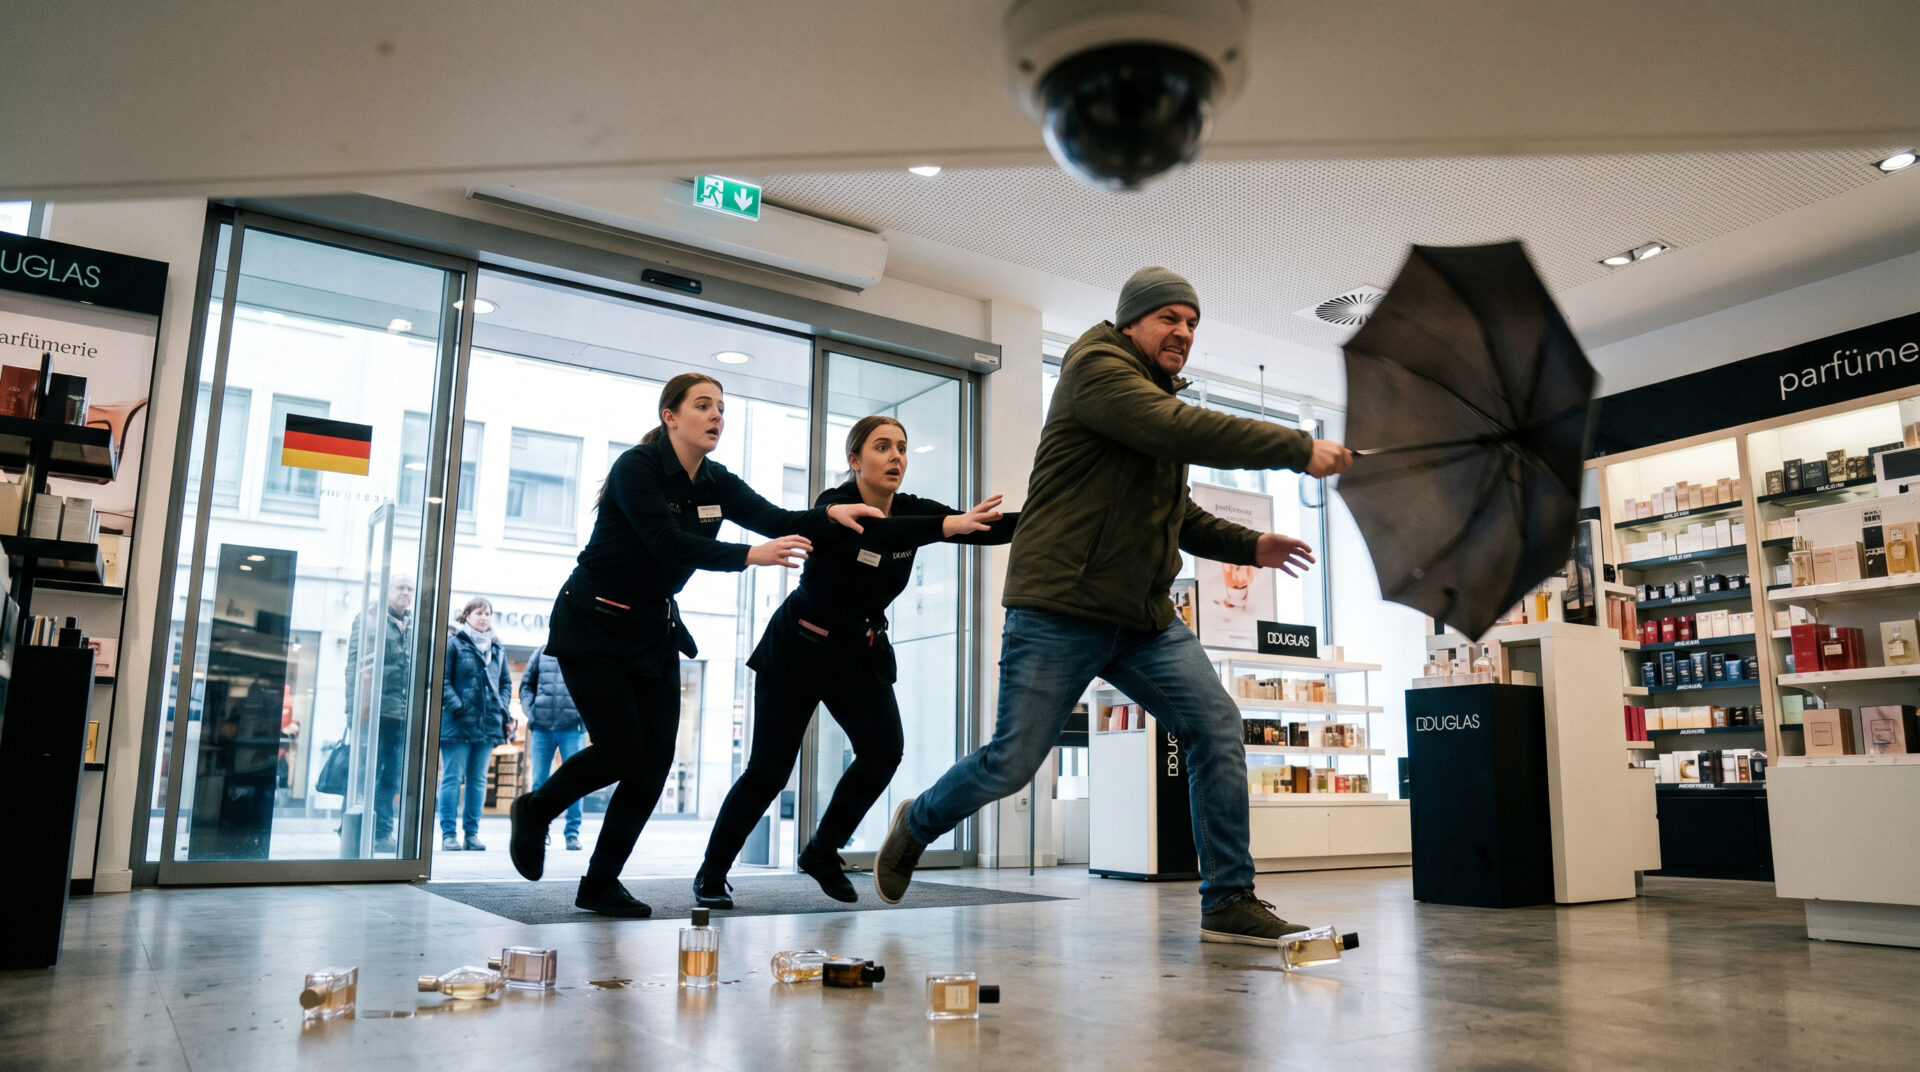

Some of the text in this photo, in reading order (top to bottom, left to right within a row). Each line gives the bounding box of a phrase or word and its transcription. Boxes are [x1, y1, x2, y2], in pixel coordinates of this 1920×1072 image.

[0, 249, 101, 288] UGLAS
[1779, 342, 1920, 401] parfüme
[1267, 632, 1310, 647] DOUGLAS
[1416, 714, 1480, 732] DOUGLAS
